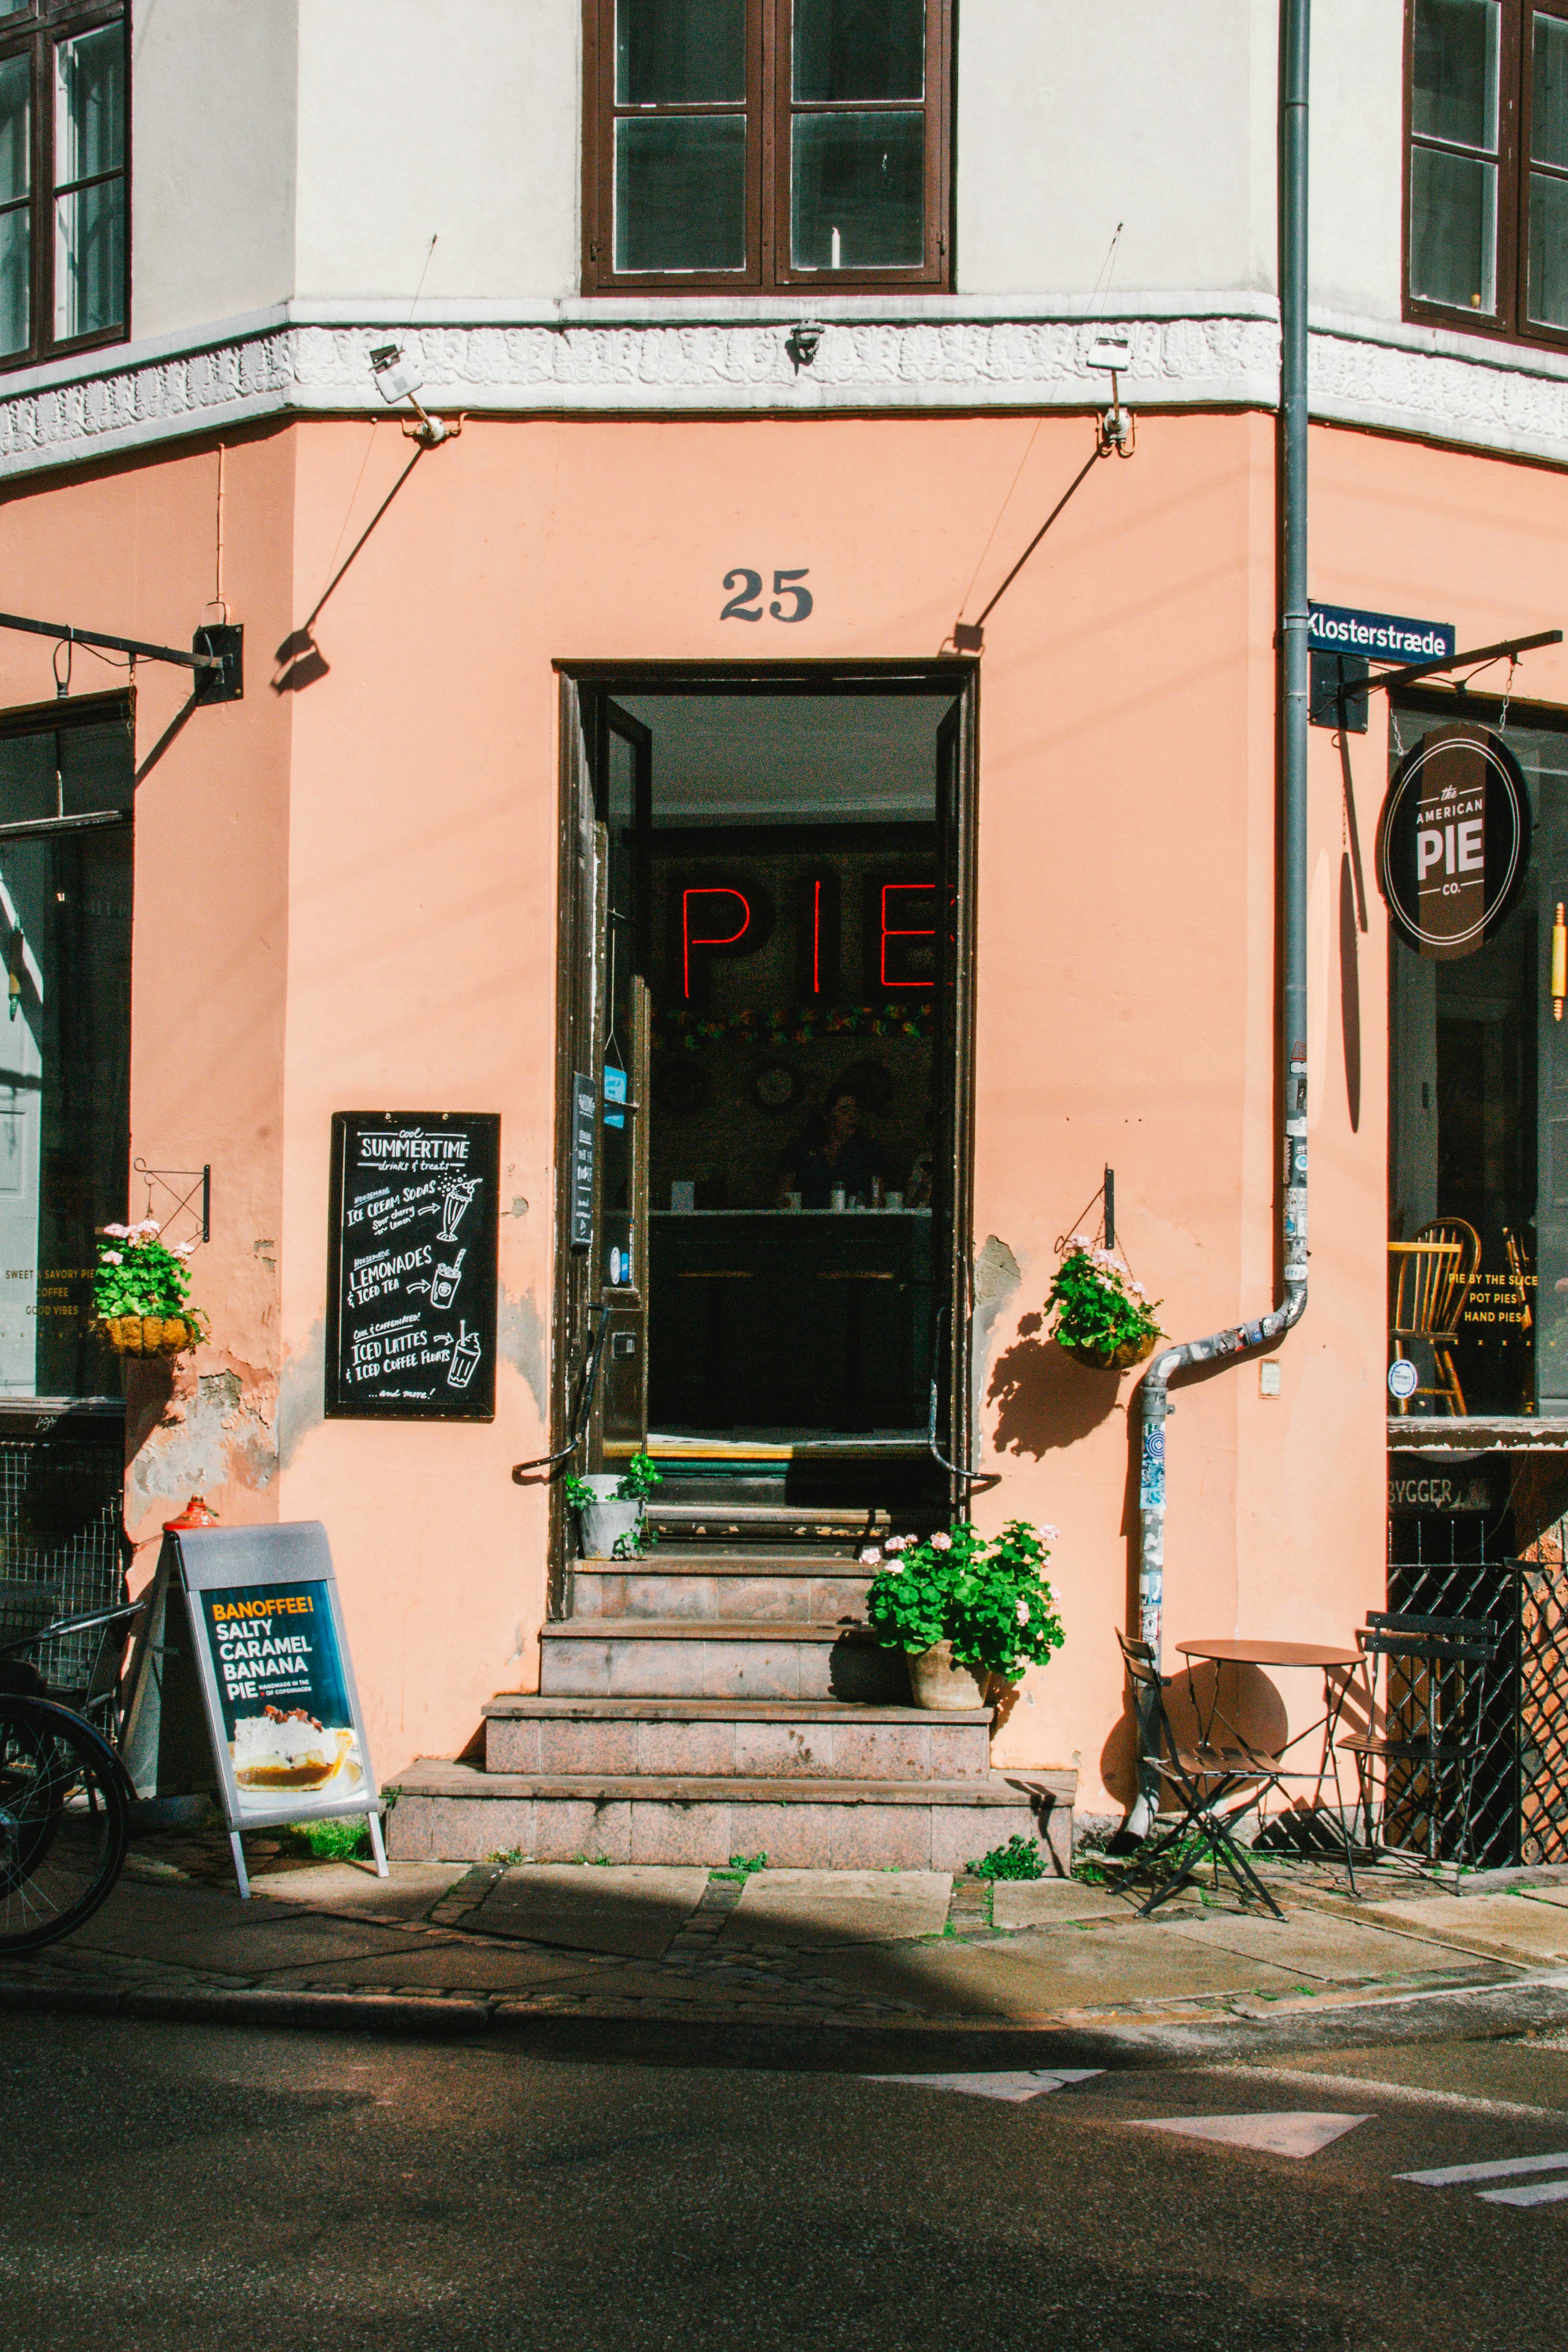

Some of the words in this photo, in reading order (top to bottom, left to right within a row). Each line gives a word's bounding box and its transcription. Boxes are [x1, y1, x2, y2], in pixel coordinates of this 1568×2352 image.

[720, 568, 814, 623] 25
[1307, 613, 1446, 656] Klosterstræde
[1441, 784, 1458, 801] the
[1416, 799, 1483, 824] AMERICAN
[1417, 818, 1484, 881] PIE
[1442, 882, 1461, 895] CO.
[684, 880, 936, 998] PIE
[399, 1127, 424, 1139] cool
[361, 1138, 471, 1159] SUMMERTIME
[378, 1160, 410, 1171] drinks
[412, 1159, 418, 1173] &
[420, 1160, 450, 1171] treats
[346, 1208, 365, 1227] ICE
[367, 1194, 400, 1218] CREAM
[403, 1180, 436, 1202] SODAS
[372, 1215, 390, 1230] Sour
[391, 1205, 415, 1220] cherry
[350, 1244, 432, 1291] LEMONADES
[354, 1249, 391, 1269] HOUSEMADE
[5, 1270, 34, 1279] SWEET
[44, 1269, 79, 1279] SAVORY
[1449, 1273, 1466, 1284] PIE
[1469, 1274, 1483, 1284] BY
[1484, 1274, 1506, 1285] THE
[1509, 1275, 1539, 1286] SLICE
[36, 1288, 68, 1298] COFFEE
[347, 1290, 355, 1309] &
[356, 1285, 380, 1305] ICED
[381, 1278, 400, 1294] TEA
[1470, 1293, 1491, 1303] POT
[1494, 1293, 1517, 1304] PIES
[26, 1305, 51, 1315] GOOD
[54, 1305, 78, 1315] VIBES
[1465, 1311, 1496, 1322] HAND
[1499, 1312, 1522, 1322] PIES
[375, 1312, 421, 1332] CAFFEINATED!
[351, 1341, 382, 1367] ICED
[385, 1330, 428, 1356] LATTES
[355, 1362, 380, 1381] ICED
[383, 1352, 418, 1373] COFFEE
[421, 1349, 451, 1364] FLOATS
[403, 1388, 436, 1400] more!
[212, 1596, 314, 1621] BANOFFEE!
[216, 1619, 273, 1641] SALTY
[219, 1636, 313, 1661] CARAMEL
[223, 1656, 309, 1681] BANANA
[227, 1681, 258, 1701] PIE
[258, 1681, 291, 1690] HANDMADE
[275, 1686, 312, 1695] COPENHAGEN
